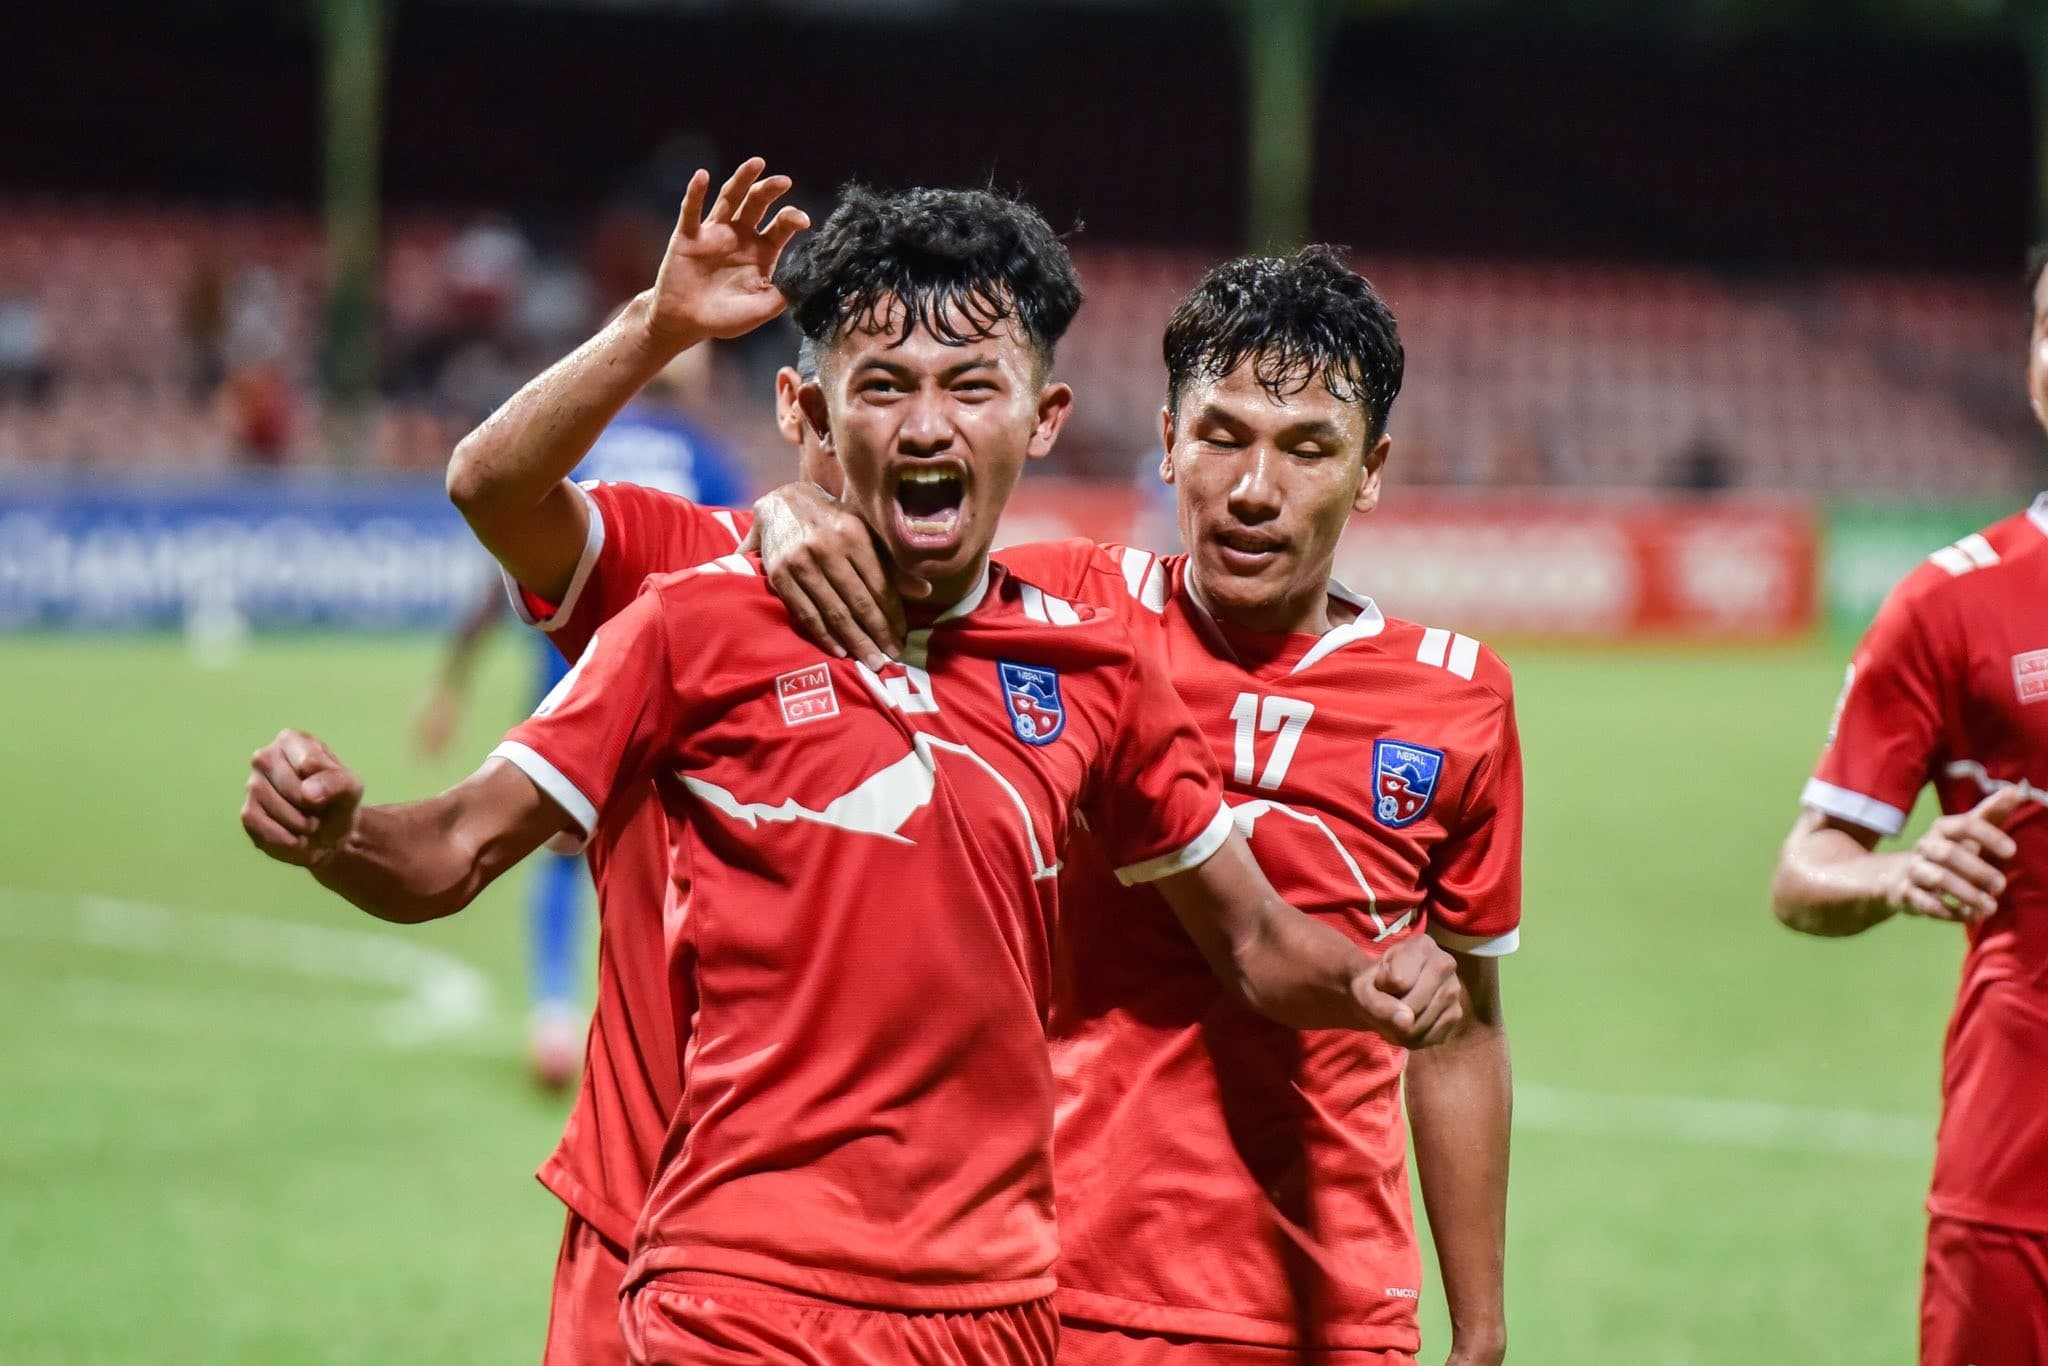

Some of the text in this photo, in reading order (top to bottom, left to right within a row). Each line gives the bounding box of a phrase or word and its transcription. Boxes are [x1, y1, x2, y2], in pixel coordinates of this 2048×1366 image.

[783, 670, 825, 692] KTM
[1017, 669, 1045, 684] NEPAL
[789, 697, 829, 716] CTY
[1229, 692, 1315, 790] 17
[1396, 749, 1425, 766] NEPAL
